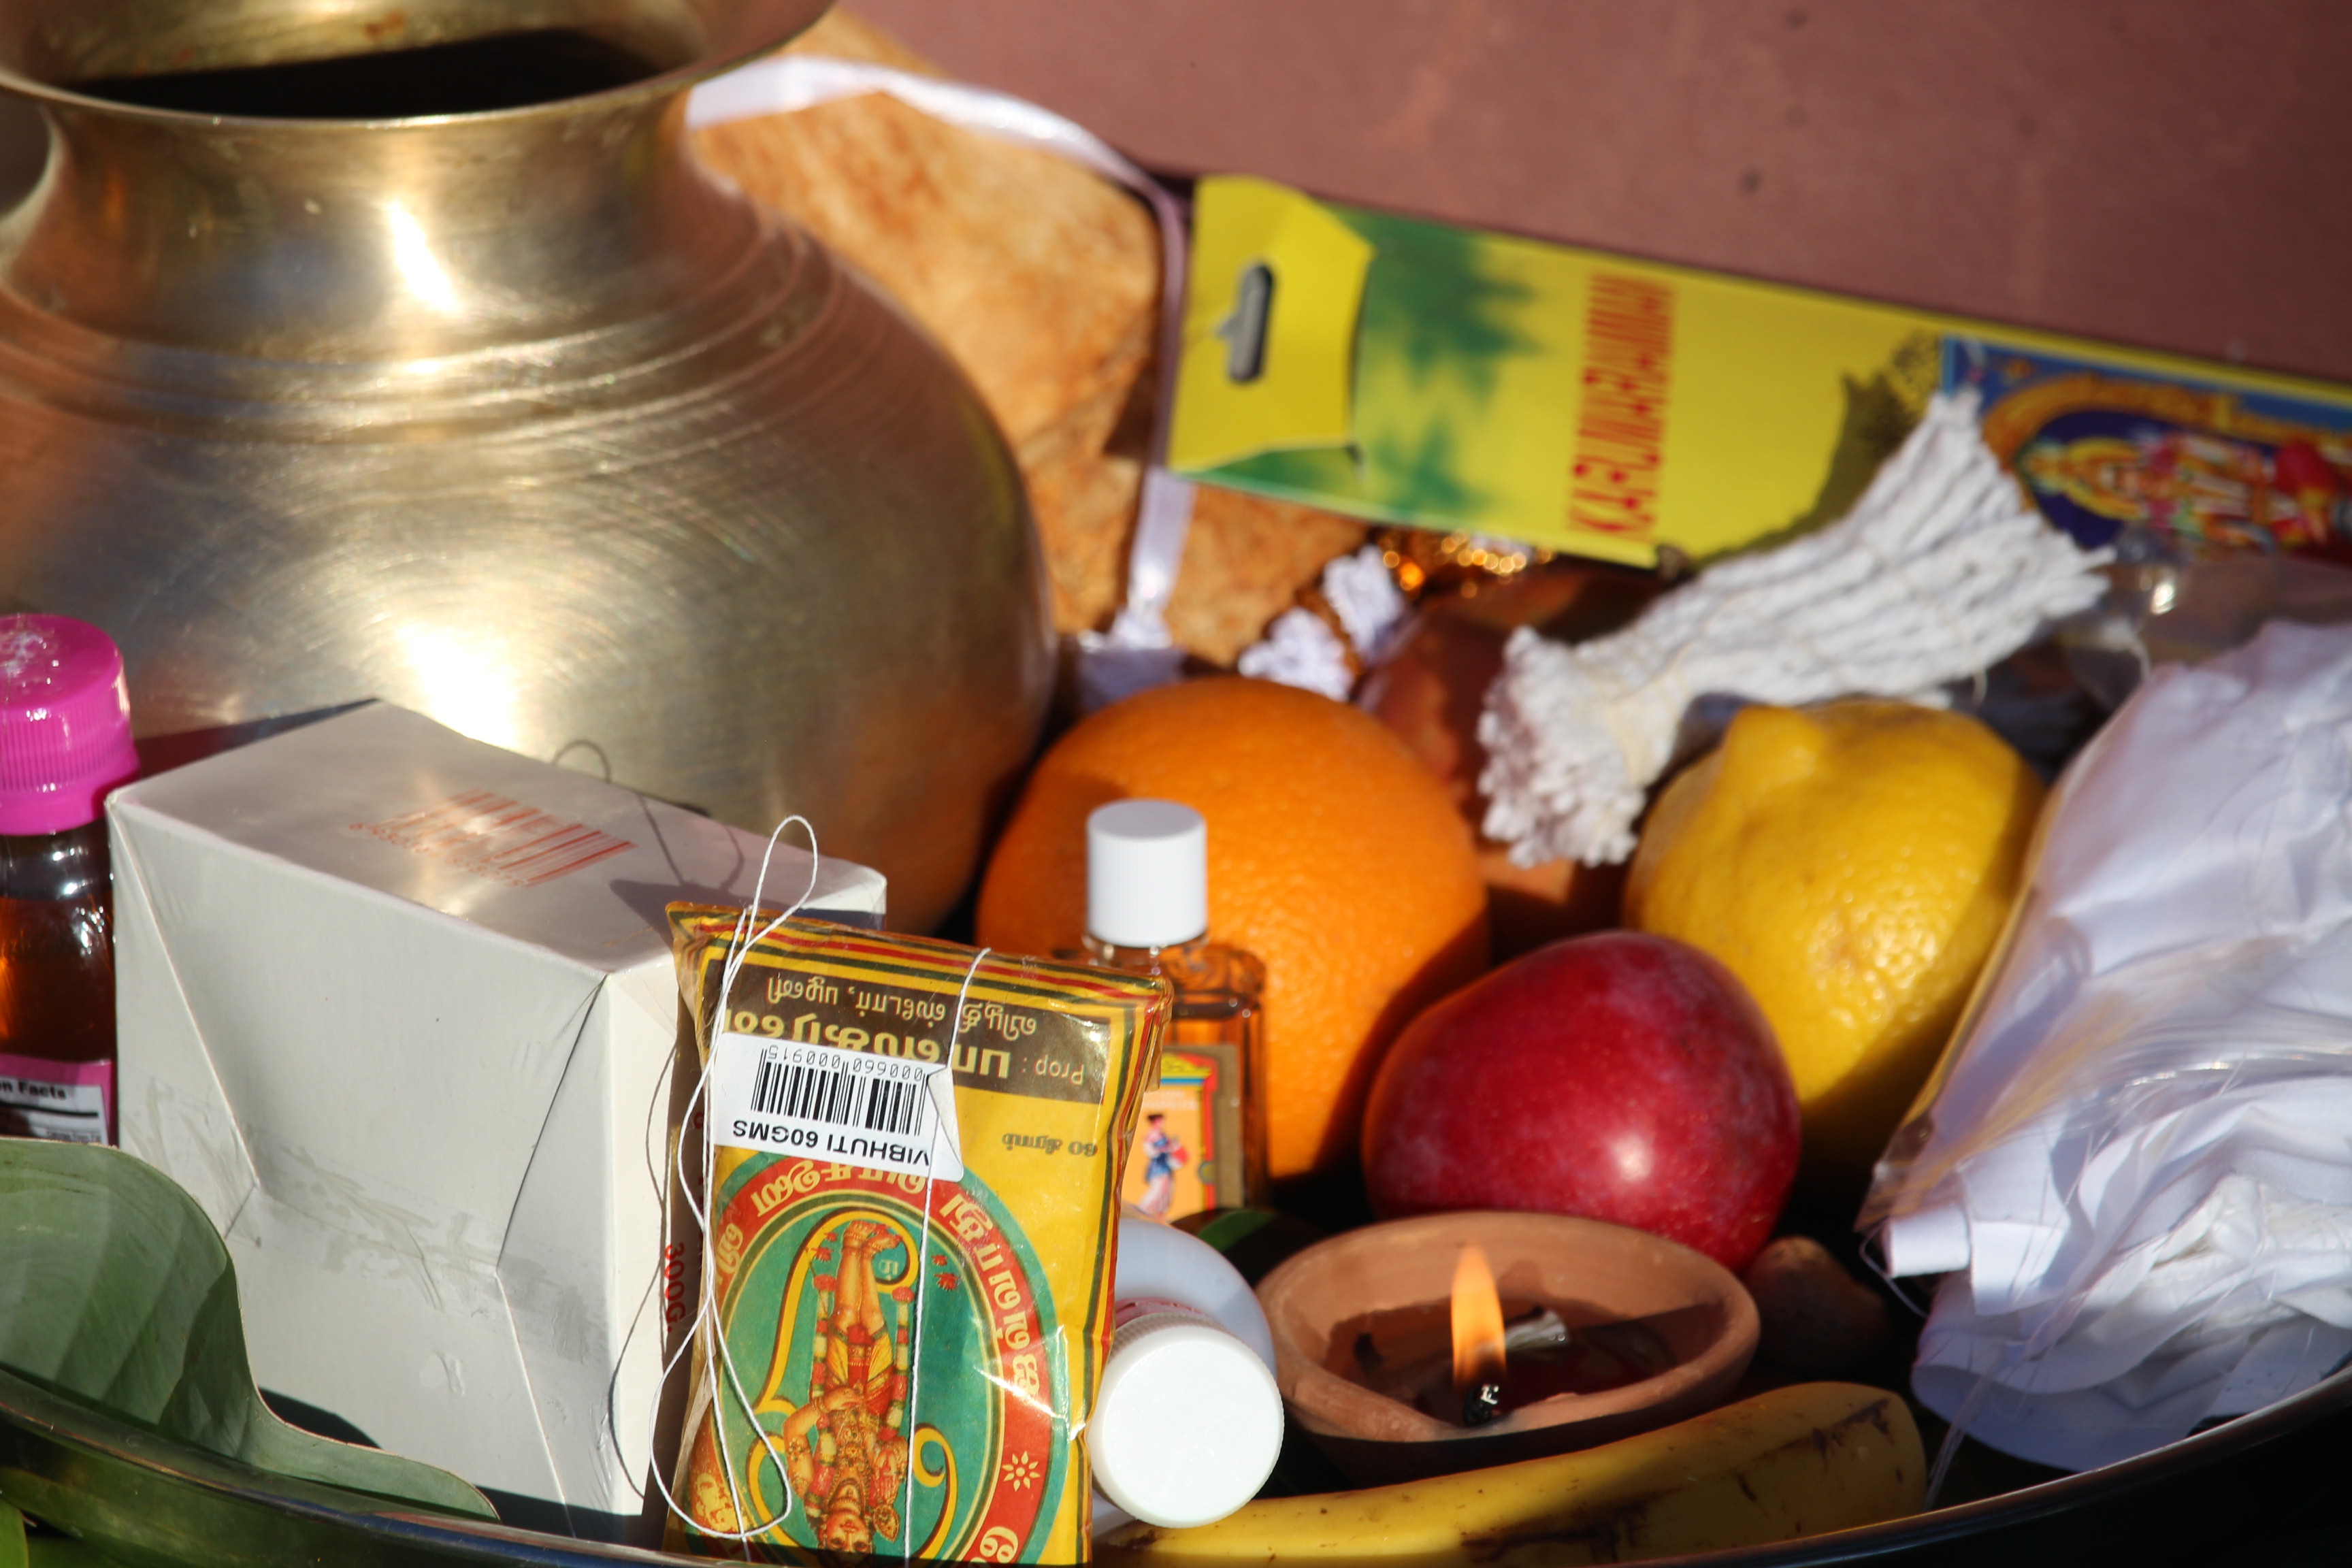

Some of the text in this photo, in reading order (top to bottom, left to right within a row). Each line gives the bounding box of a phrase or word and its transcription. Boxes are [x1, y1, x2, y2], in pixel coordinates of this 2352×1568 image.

[768, 976, 838, 1006] பழனி
[958, 1001, 1038, 1041] விபூதி
[767, 1045, 924, 1082] 000660 000915
[18, 1080, 67, 1099] Facts
[732, 1120, 930, 1166] VIBHUTI 60GMS
[1001, 1132, 1063, 1154] கிராம்
[663, 1242, 687, 1334] 300G.
